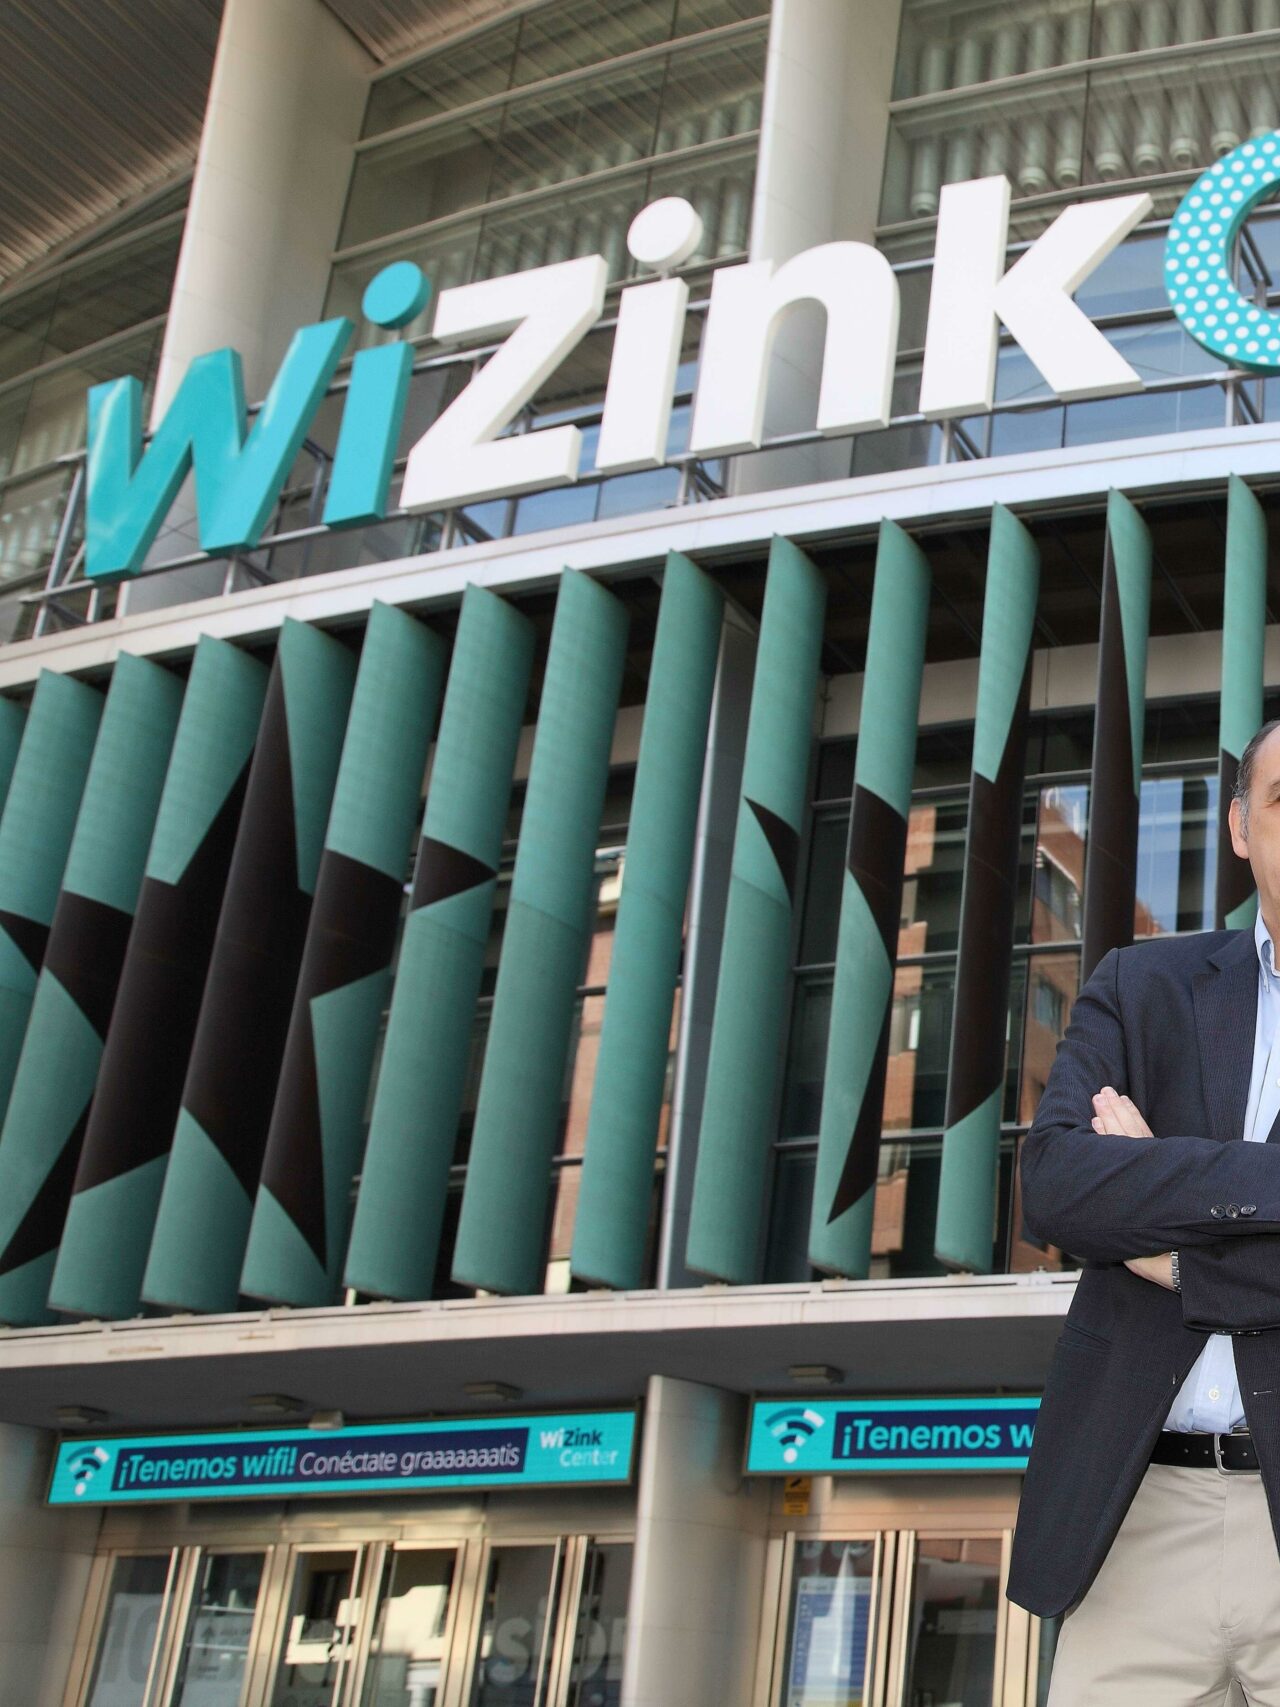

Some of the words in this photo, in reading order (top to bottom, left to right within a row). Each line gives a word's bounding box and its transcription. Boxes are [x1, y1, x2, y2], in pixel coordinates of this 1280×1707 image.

[841, 1418, 1003, 1457] ¡Tenemos
[117, 1453, 239, 1489] ¡Tenemos
[242, 1446, 299, 1478] wifi!
[299, 1450, 399, 1477] Conéctate
[559, 1448, 619, 1468] Center
